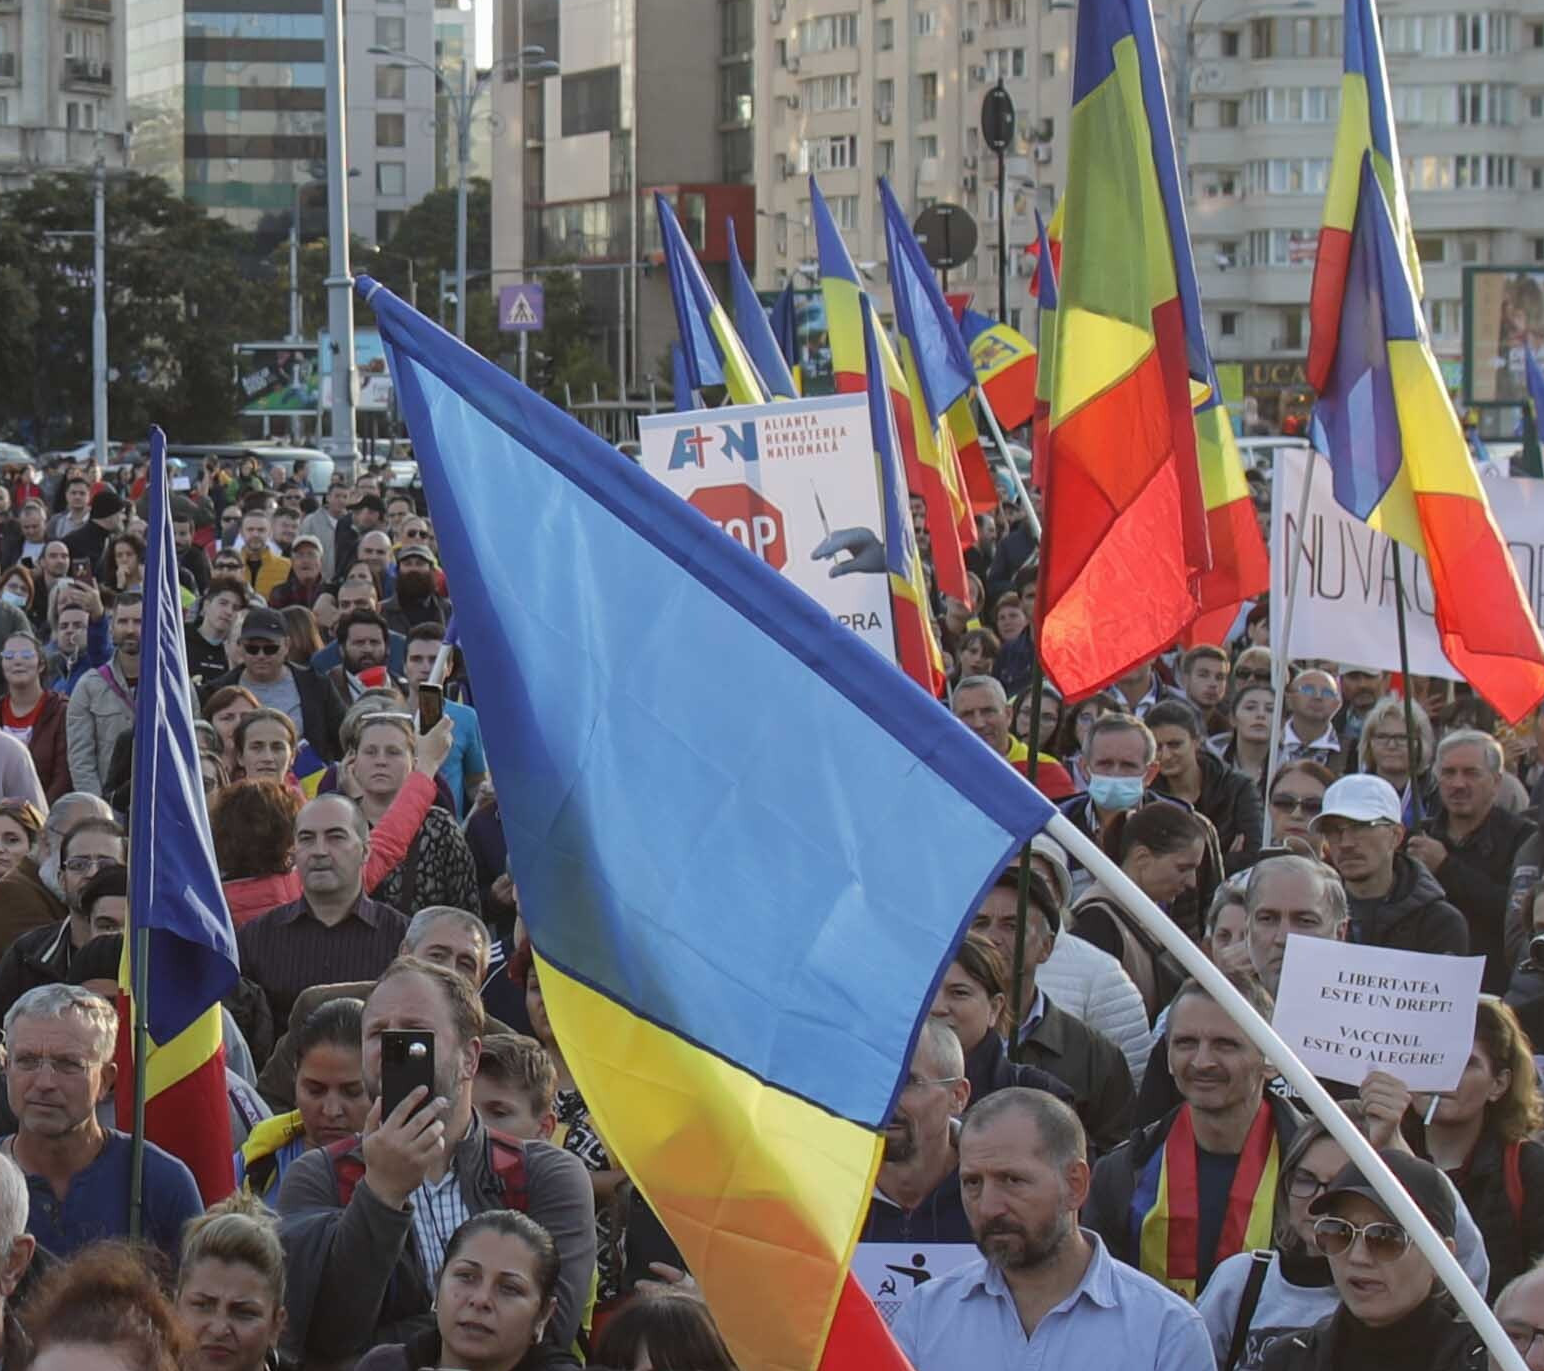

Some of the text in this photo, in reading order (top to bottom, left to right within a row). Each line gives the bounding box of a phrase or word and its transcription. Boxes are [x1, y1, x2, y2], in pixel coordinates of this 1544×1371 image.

[1337, 970, 1441, 995] LIBERTATEA
[1320, 985, 1453, 1014] ESTE UN DREPT!
[1338, 1025, 1423, 1048] VACCINUL
[1302, 1035, 1445, 1066] ESTE O ALEGERE!
